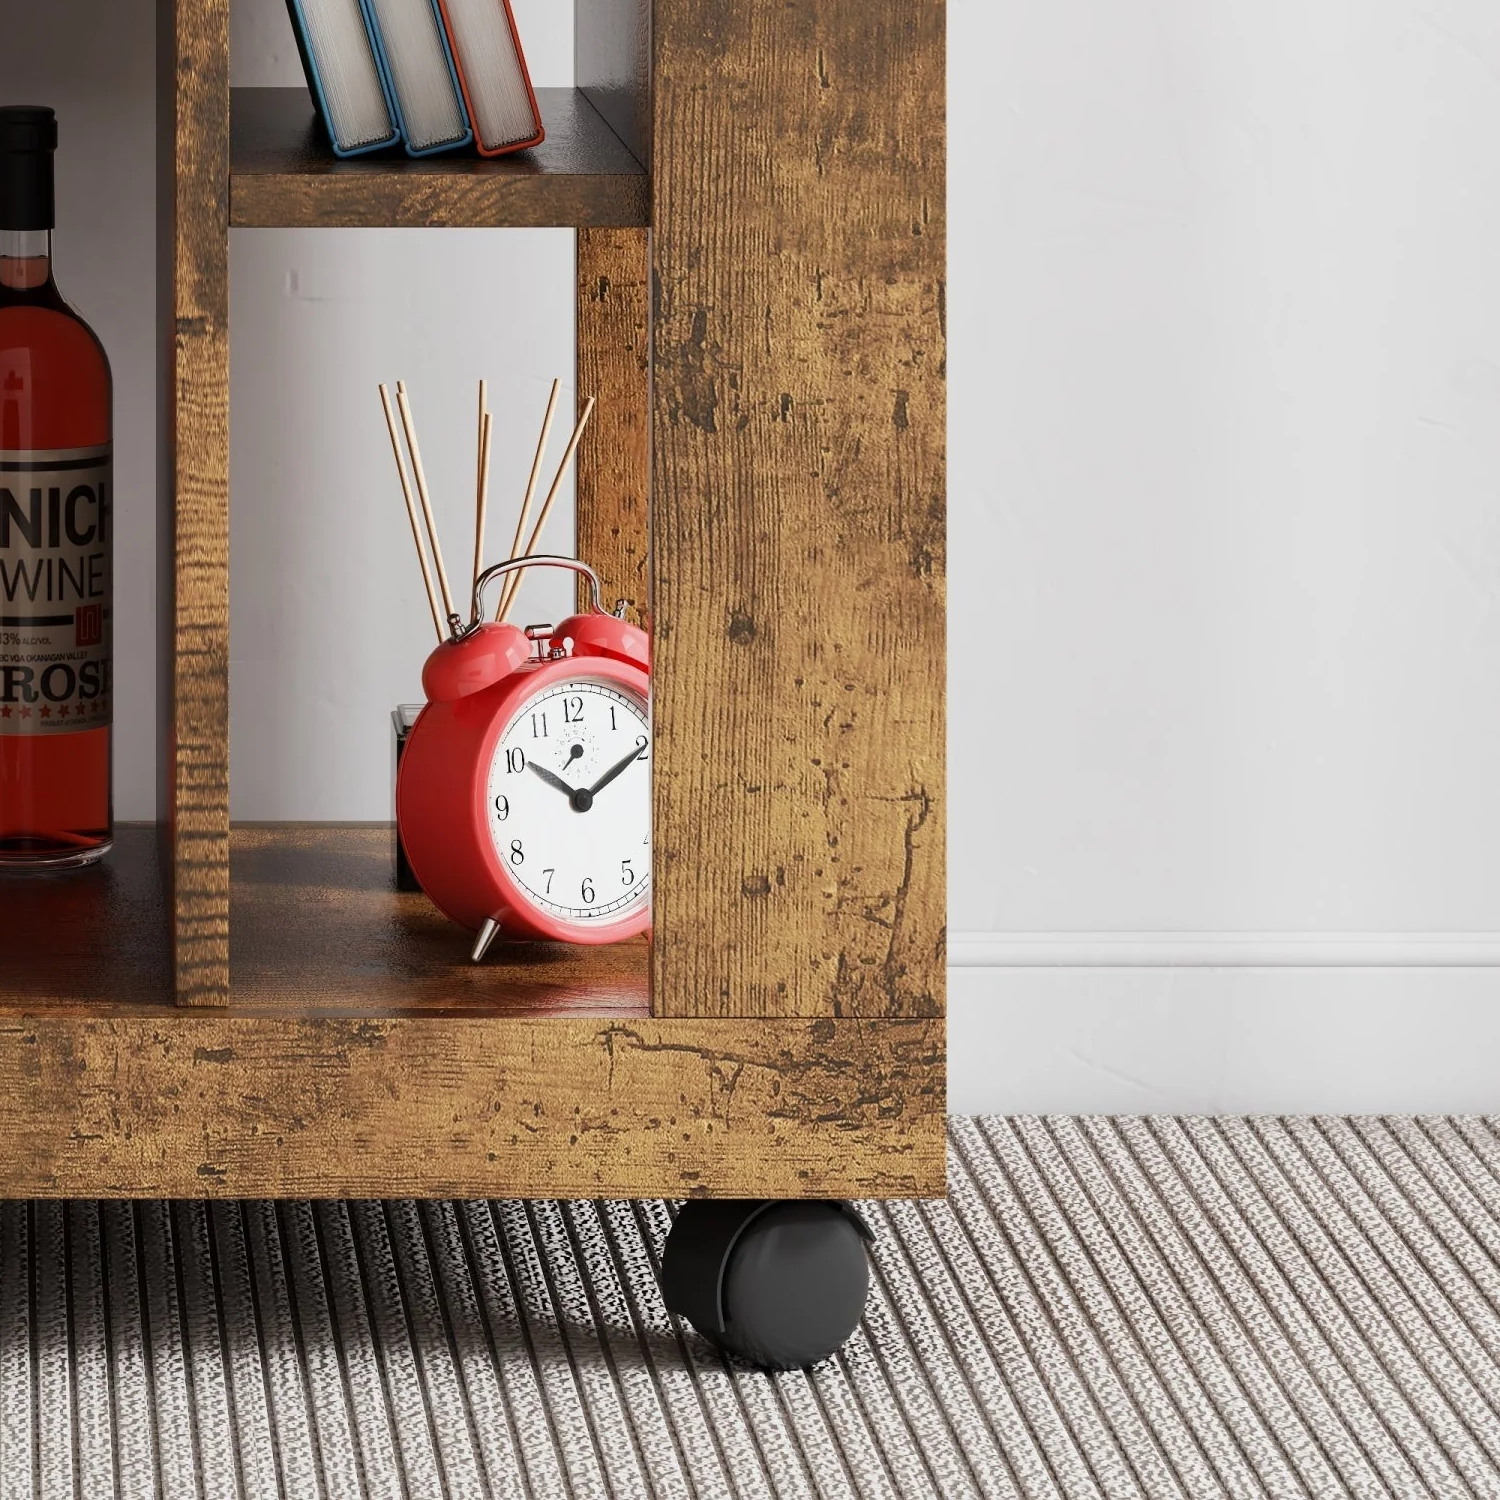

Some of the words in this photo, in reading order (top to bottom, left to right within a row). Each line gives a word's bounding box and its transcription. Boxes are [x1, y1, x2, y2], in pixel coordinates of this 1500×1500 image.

[0, 633, 21, 645] 13%
[563, 697, 584, 723] 12
[609, 706, 618, 731] 1
[531, 712, 549, 738] 11
[506, 747, 525, 774] 10
[636, 735, 649, 760] 2
[495, 795, 509, 821] 9
[510, 839, 525, 866] 8
[542, 868, 555, 894] 7
[621, 859, 635, 886] 5
[581, 877, 595, 904] 6
